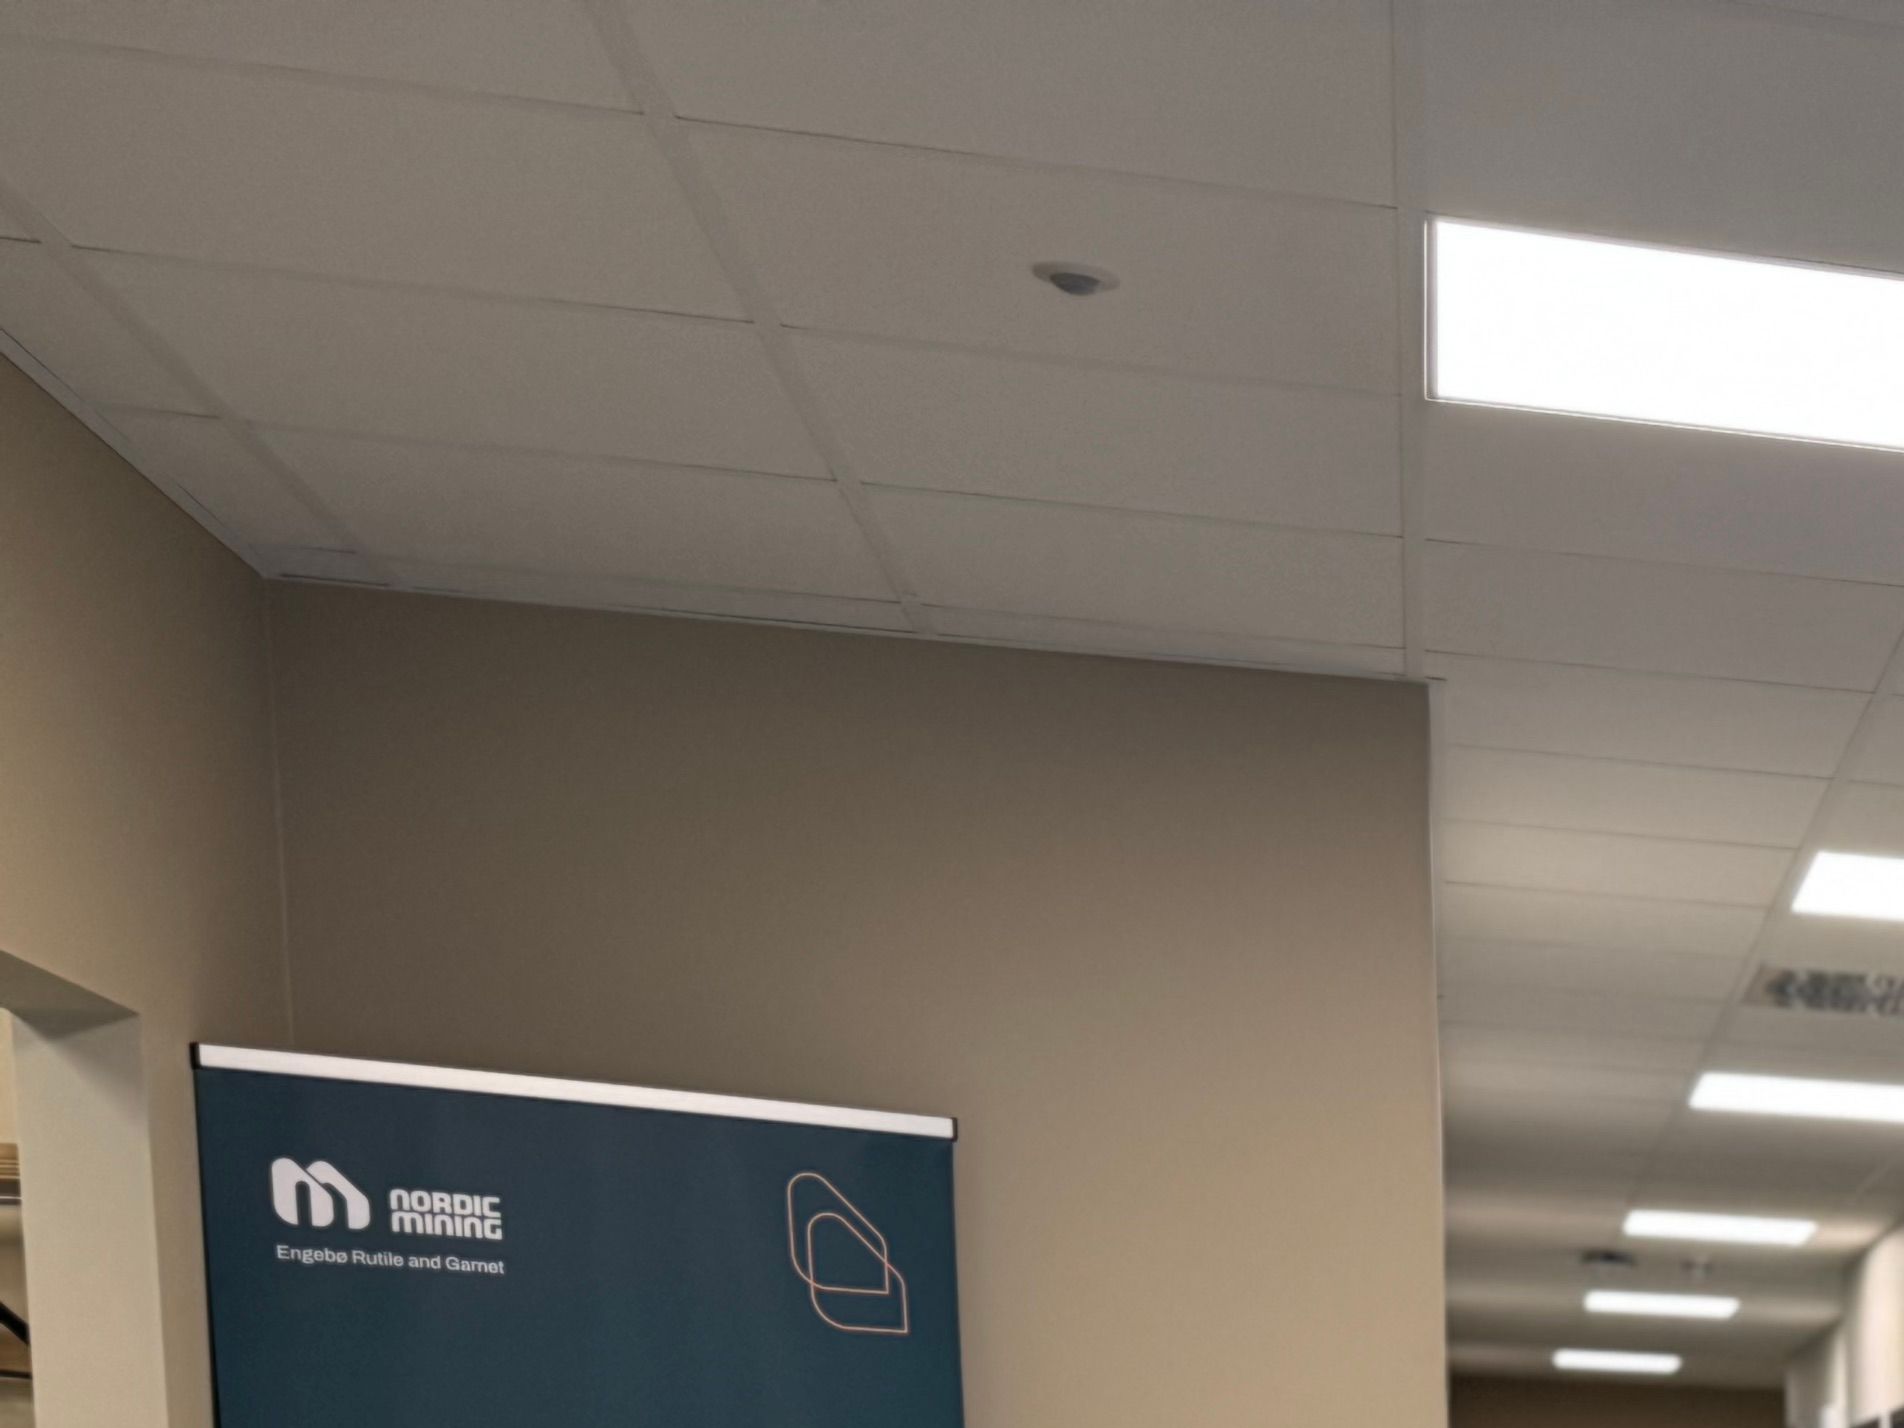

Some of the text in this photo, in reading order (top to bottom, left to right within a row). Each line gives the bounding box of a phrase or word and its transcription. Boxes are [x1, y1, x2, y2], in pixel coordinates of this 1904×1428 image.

[389, 1188, 502, 1218] NORDIC
[391, 1211, 503, 1240] MINING
[276, 1244, 505, 1274] Engebø Rutile and Garnet
